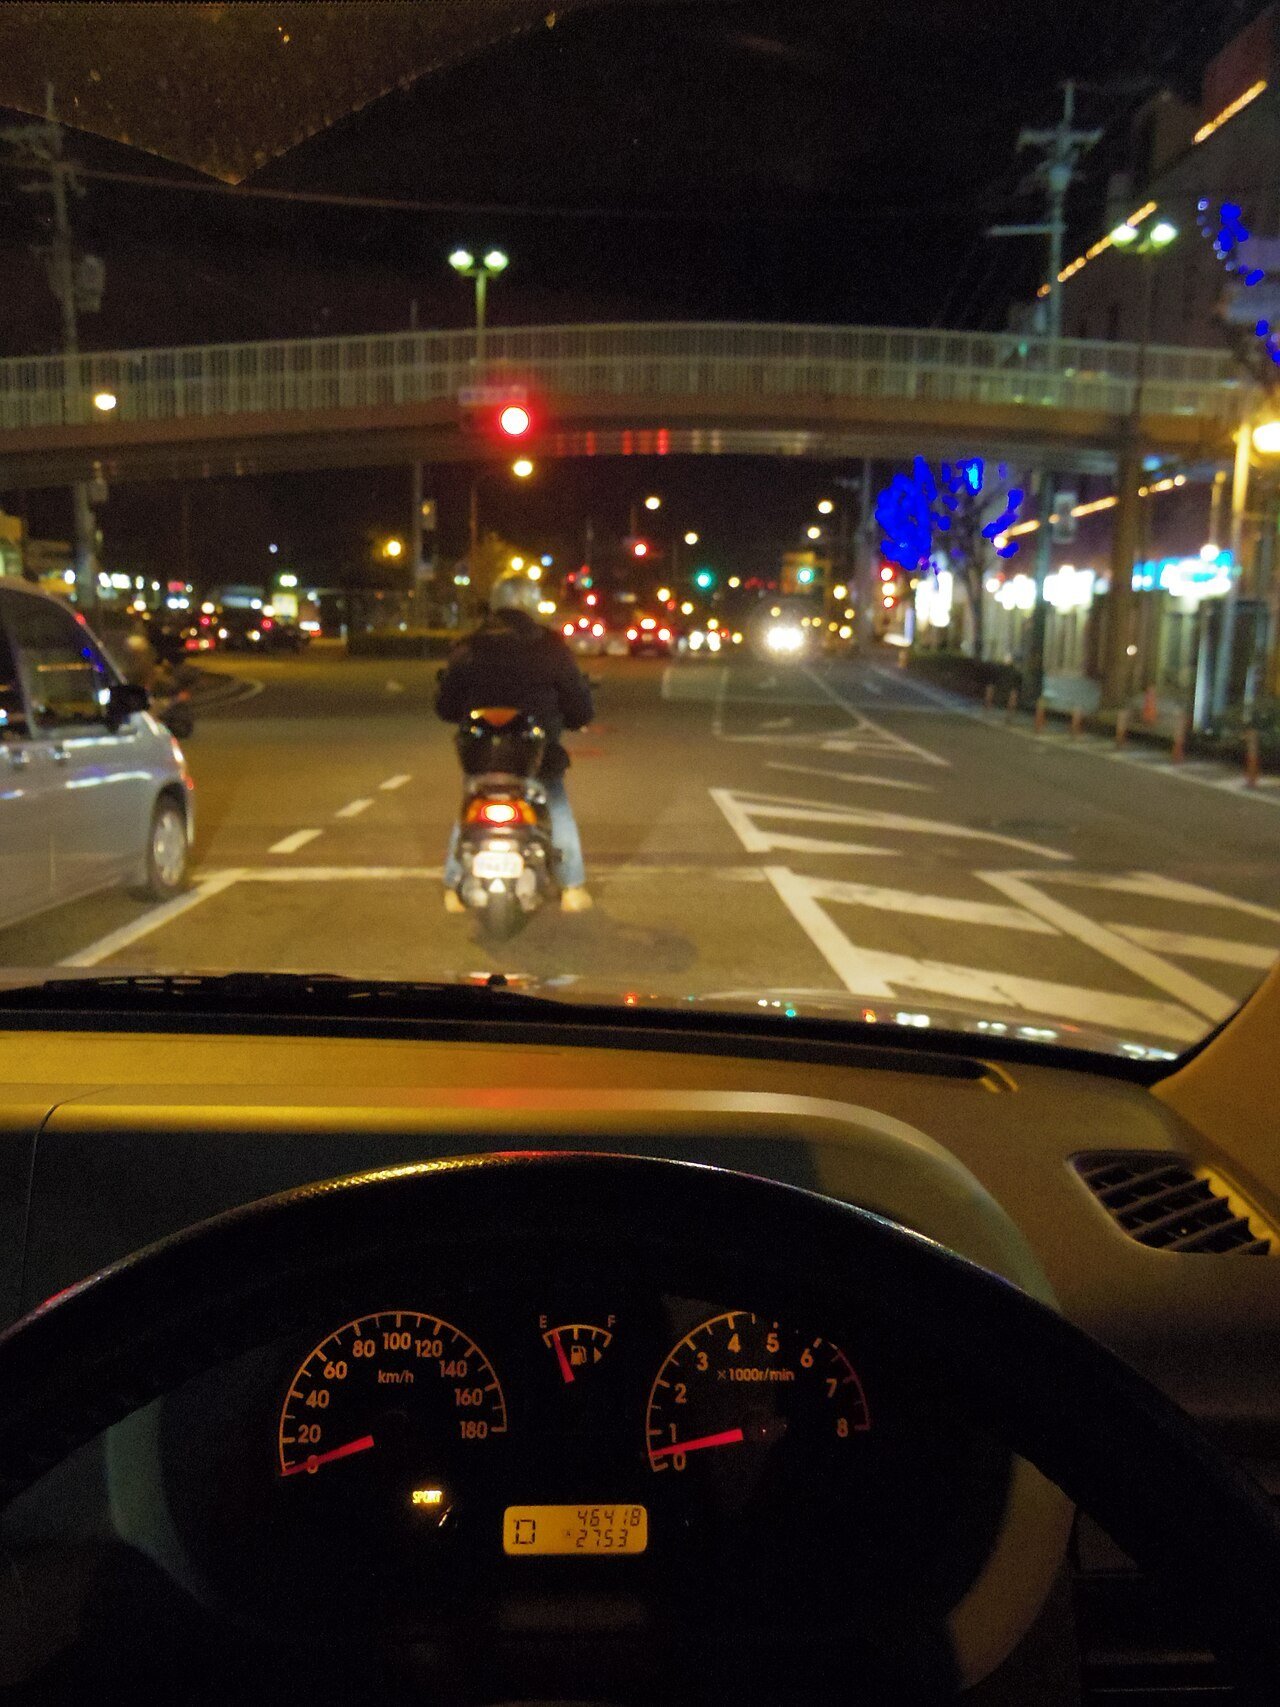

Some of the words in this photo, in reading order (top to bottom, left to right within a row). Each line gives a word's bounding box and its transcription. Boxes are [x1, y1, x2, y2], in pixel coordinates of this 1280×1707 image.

[539, 1315, 547, 1328] E
[607, 1315, 616, 1327] F
[352, 1340, 376, 1358] 80
[383, 1332, 411, 1349] 100
[415, 1339, 443, 1358] 120
[727, 1333, 741, 1353] 4
[766, 1333, 779, 1353] 5
[696, 1352, 708, 1371] 3
[800, 1348, 814, 1368] 6
[323, 1361, 348, 1380] 60
[377, 1369, 414, 1384] km/h
[439, 1360, 468, 1377] 140
[454, 1388, 483, 1406] 160
[674, 1383, 687, 1404] 2
[826, 1378, 838, 1398] 7
[305, 1389, 330, 1408] 40
[298, 1424, 321, 1443] 20
[459, 1421, 488, 1439] 180
[669, 1423, 678, 1443] 1
[836, 1418, 849, 1438] 8
[673, 1450, 686, 1471] 0
[577, 1508, 641, 1527] 46418
